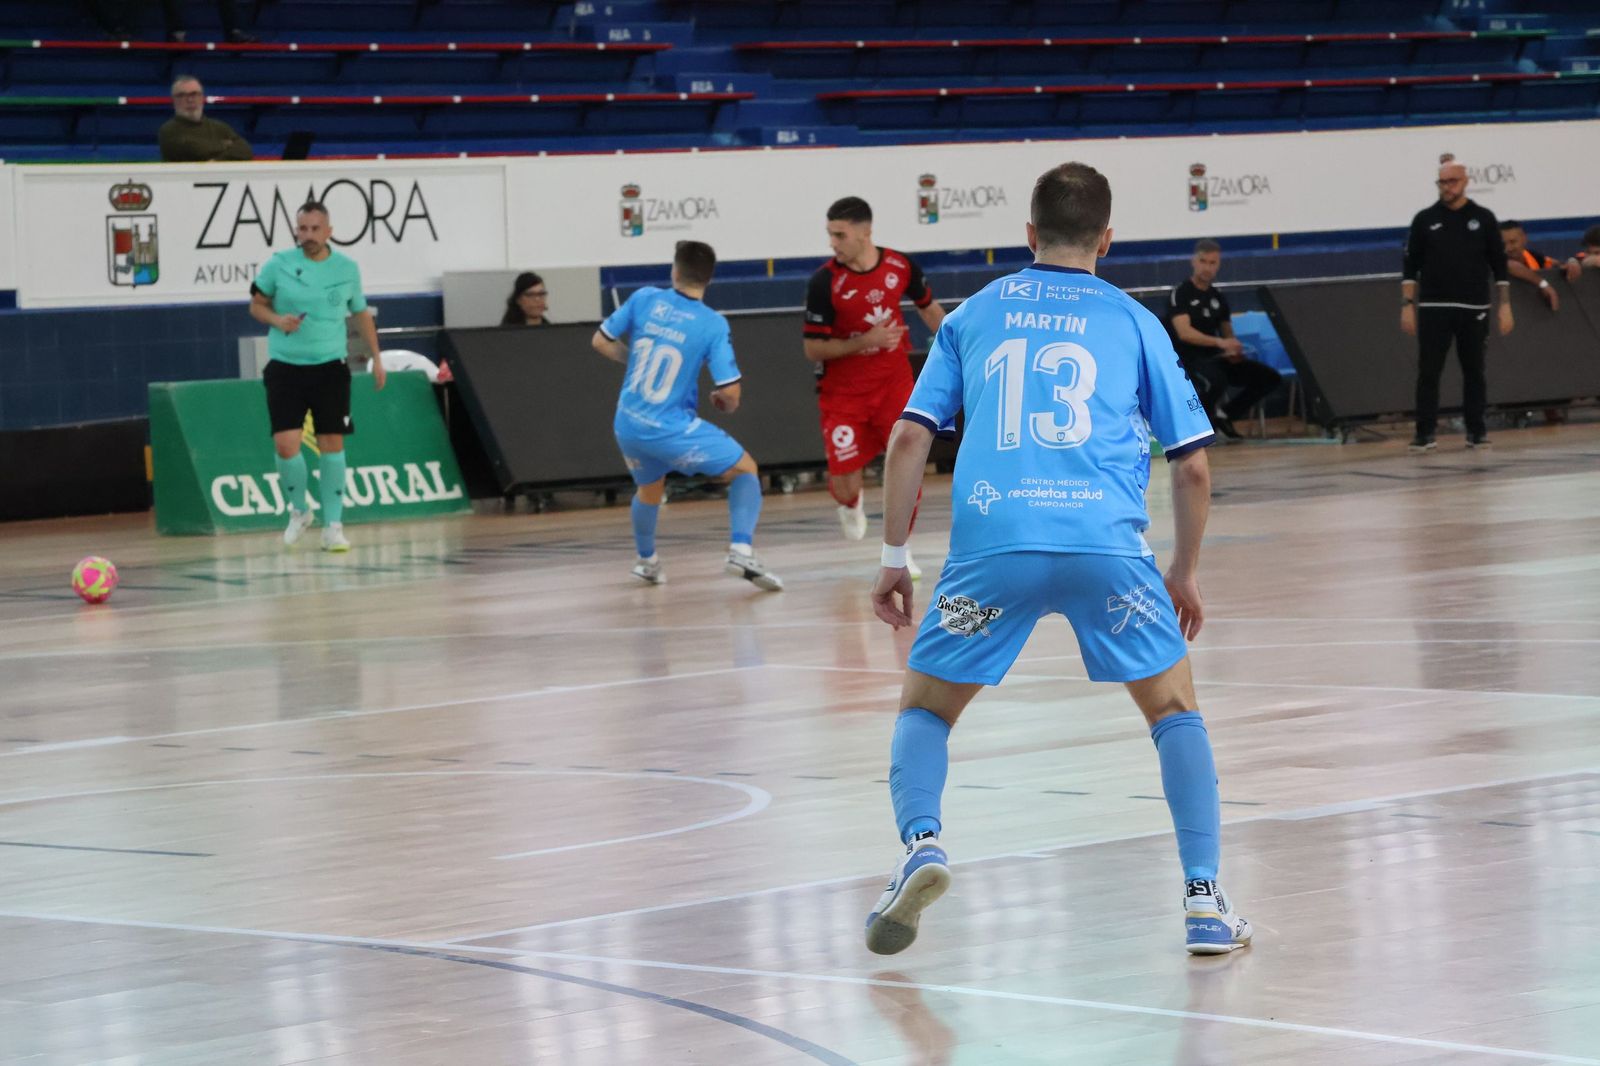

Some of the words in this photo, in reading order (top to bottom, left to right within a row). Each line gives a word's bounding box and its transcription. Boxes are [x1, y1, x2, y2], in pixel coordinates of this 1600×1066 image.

[941, 185, 1008, 209] ZAMORA
[1209, 174, 1272, 198] ZAMORA
[193, 179, 438, 249] ZAMORA
[645, 197, 720, 222] ZAMORA
[1046, 293, 1080, 301] PLUS
[1005, 312, 1087, 335] MARTÍN
[630, 336, 684, 405] 10
[985, 338, 1097, 451] 13
[312, 461, 463, 508] URAL
[1008, 487, 1068, 499] recoletas
[1071, 489, 1103, 500] salud
[1020, 478, 1055, 486] CENTRO
[1028, 501, 1084, 509] CAMPOAMOR
